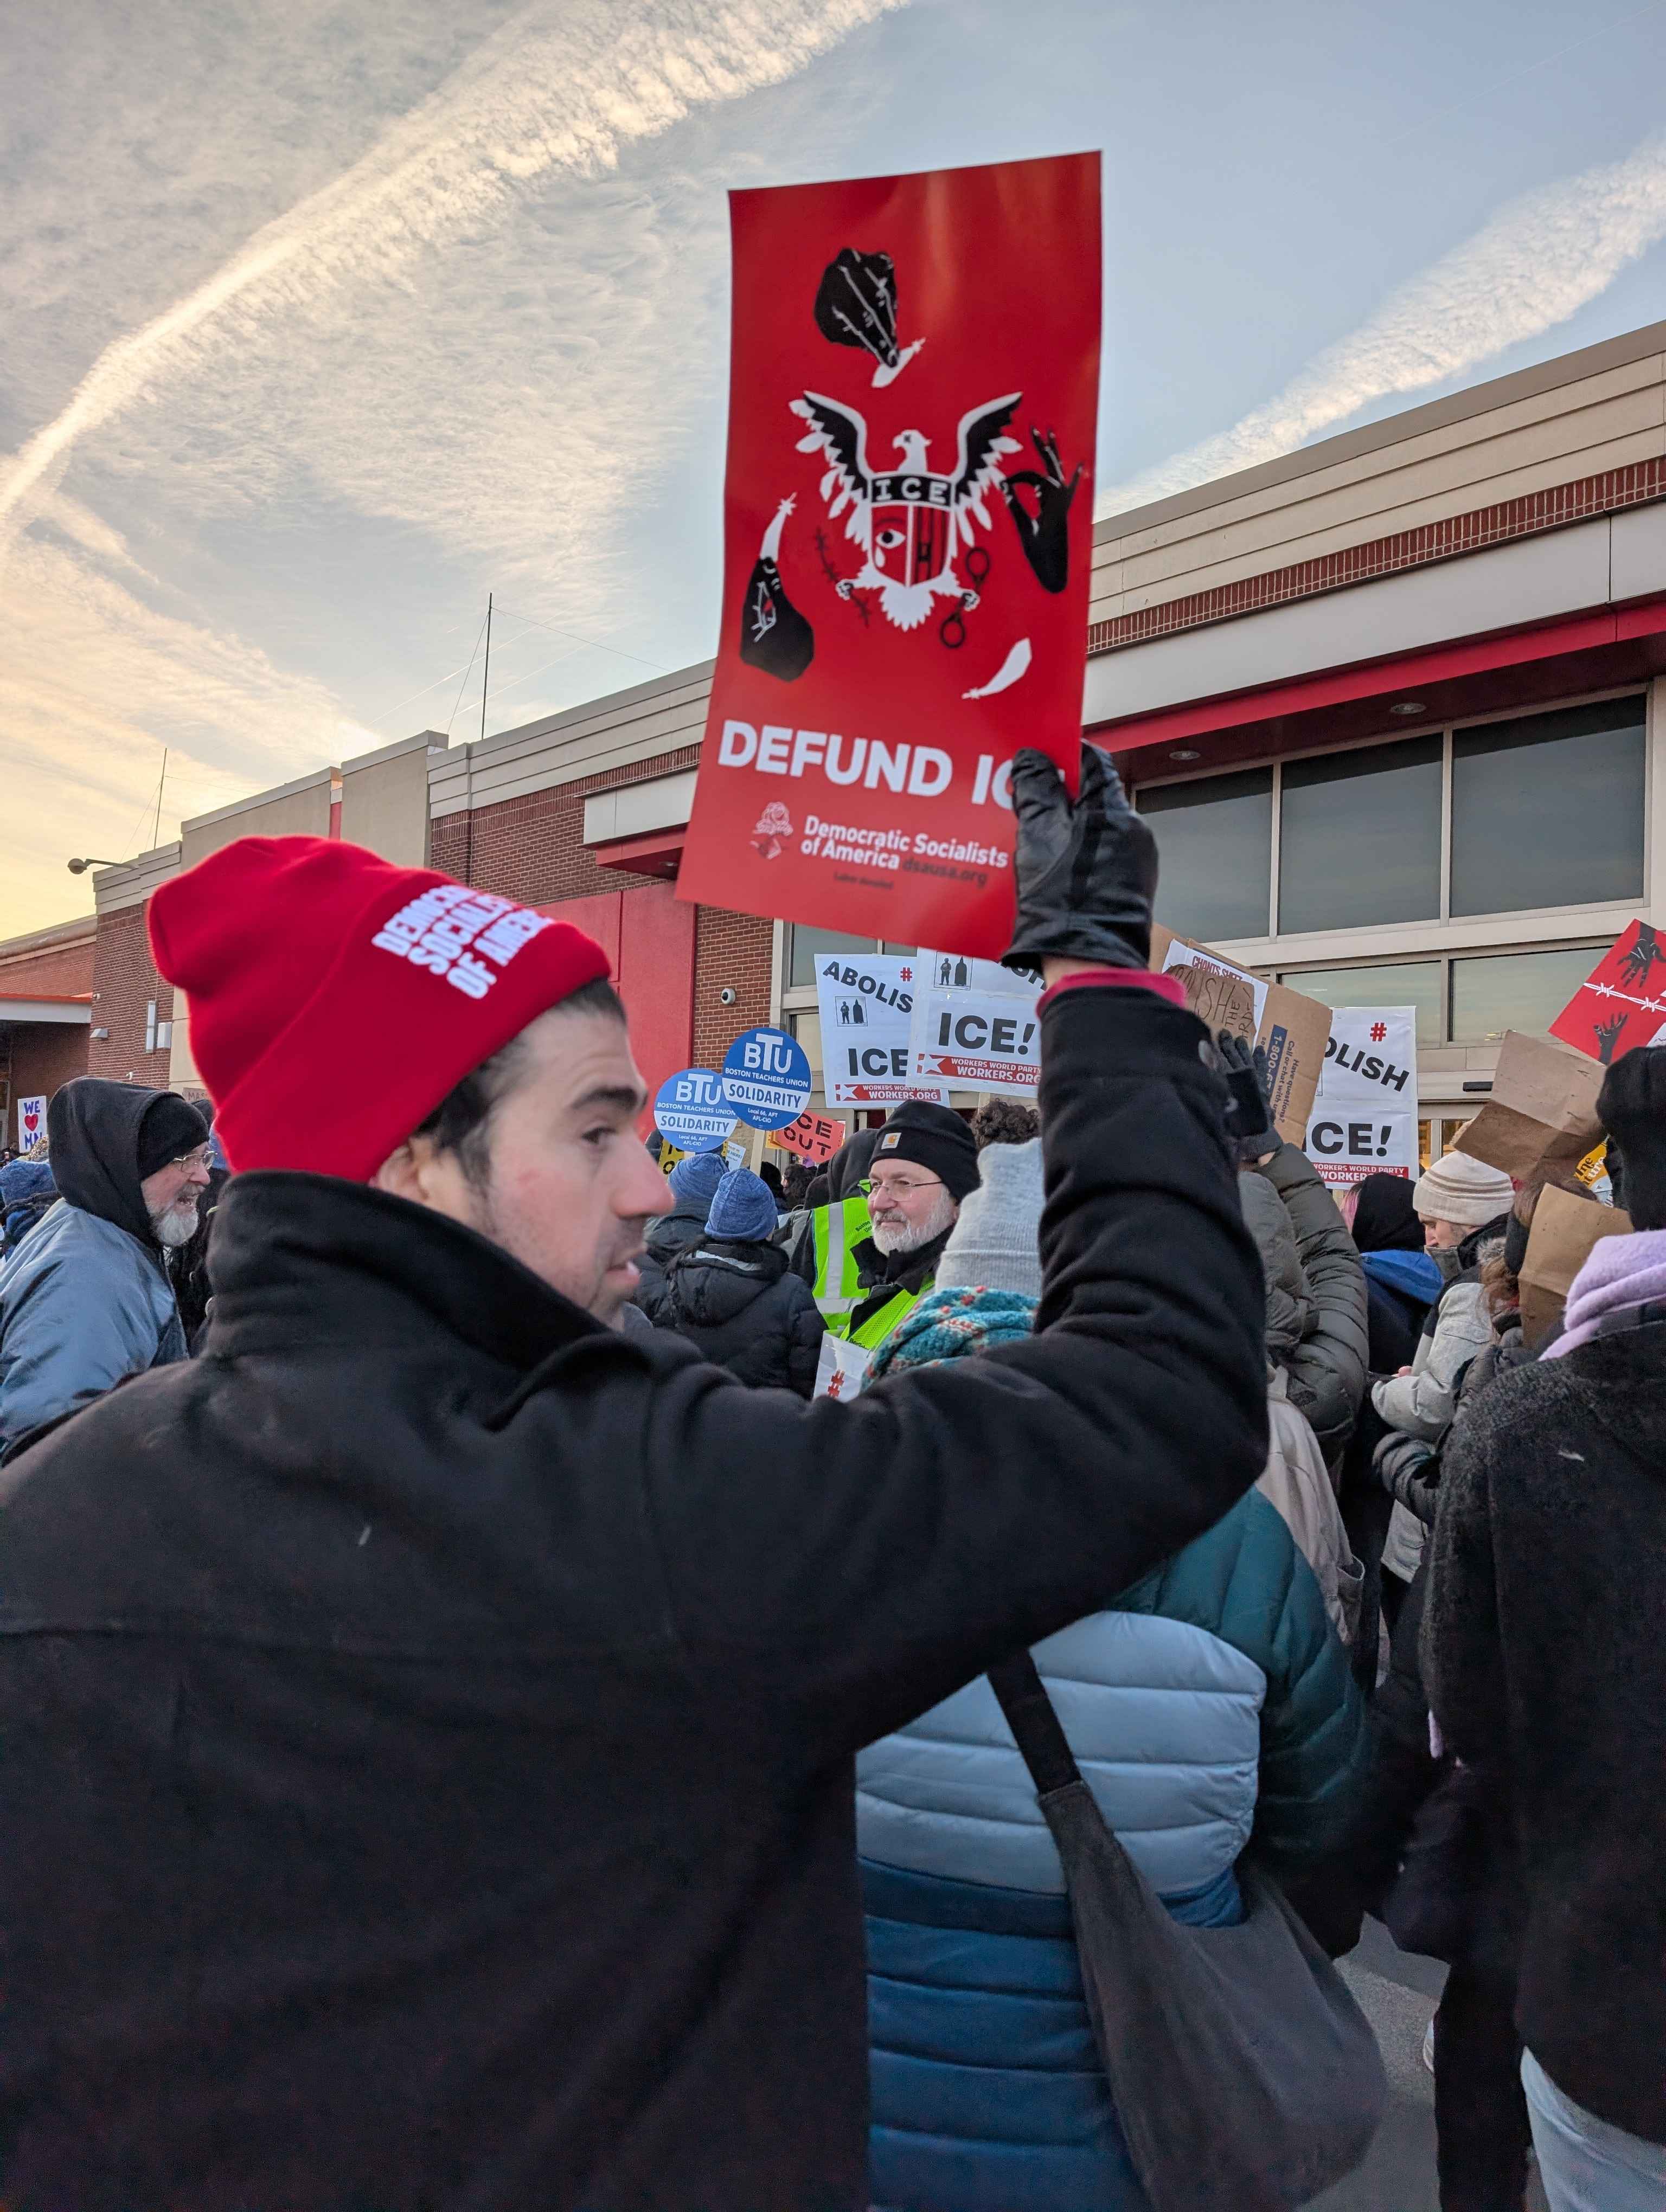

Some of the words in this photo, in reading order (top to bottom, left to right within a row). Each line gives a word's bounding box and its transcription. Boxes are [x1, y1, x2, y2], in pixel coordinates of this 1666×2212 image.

[874, 478, 948, 505] ICE
[717, 719, 953, 798] DEFUND
[800, 837, 821, 854] of
[821, 839, 901, 870] America
[804, 814, 911, 852] Democratic
[913, 833, 1009, 869] Socialists
[446, 951, 497, 999] OF
[823, 961, 913, 1014] ABOLIS
[939, 1012, 1035, 1055] ICE!
[744, 1033, 792, 1073] BTU
[951, 1058, 988, 1068] WORKERS
[989, 1062, 1016, 1071] WORLD
[1324, 1036, 1410, 1092] OLISH
[725, 1068, 751, 1078] BOSTON
[752, 1072, 784, 1084] TEACHERS
[786, 1079, 808, 1088] UNION
[957, 1066, 1042, 1084] WORKERS.ORG
[676, 1073, 721, 1105] BTU
[729, 1083, 801, 1108] SOLIDARITY
[868, 1091, 938, 1099] WORKERS.ORG
[23, 1100, 40, 1114] WE
[683, 1105, 714, 1113] TEACHERS
[752, 1115, 772, 1123] AFL-CIO
[661, 1115, 729, 1133] SOLIDARITY
[797, 1113, 832, 1138] CE
[784, 1127, 831, 1156] OUT
